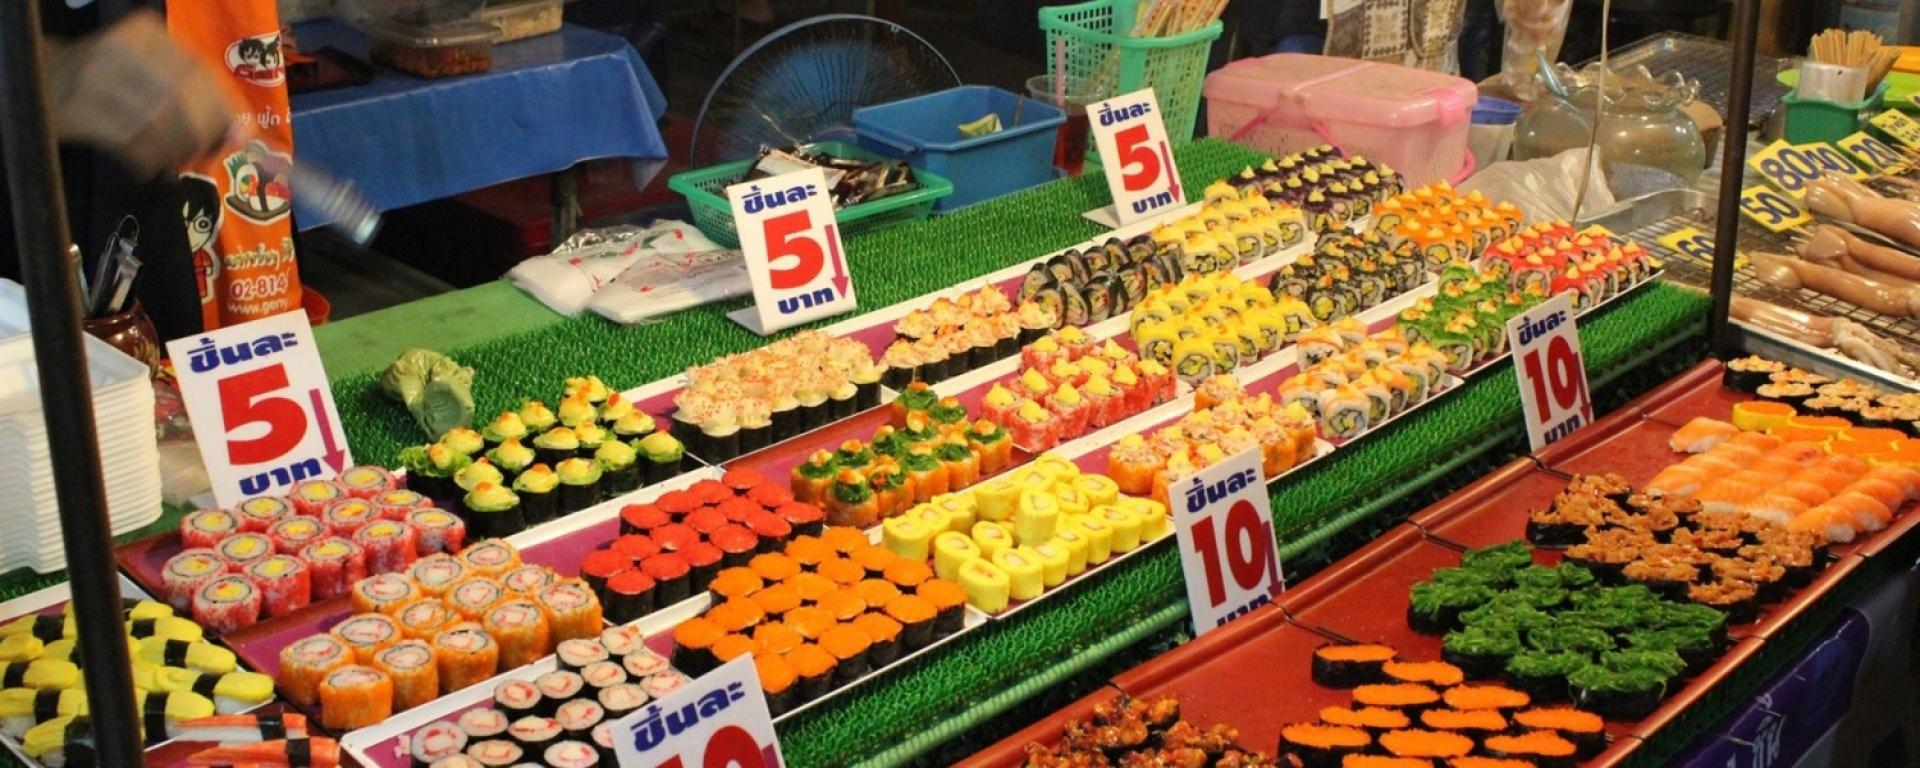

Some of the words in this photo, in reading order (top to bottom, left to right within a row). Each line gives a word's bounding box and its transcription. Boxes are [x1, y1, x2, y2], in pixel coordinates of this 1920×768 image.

[1098, 102, 1152, 126] ชิ้นละ
[1115, 123, 1161, 191] 5
[1760, 148, 1821, 191] 80
[742, 185, 817, 214] ชิ้นละ
[1132, 192, 1172, 213] บาท
[1741, 192, 1800, 224] 50
[763, 209, 824, 289] 5
[778, 288, 834, 314] บาท
[1517, 311, 1566, 345] ชิ้นละ
[187, 332, 298, 373] ชิ้นละ
[1524, 335, 1578, 424] 10
[218, 363, 308, 465] 5
[1544, 414, 1580, 445] บาท
[239, 458, 322, 495] บาท
[1185, 468, 1256, 513] ชิ้นละ
[1191, 499, 1267, 608] 10
[630, 681, 746, 752] ชิ้นละ
